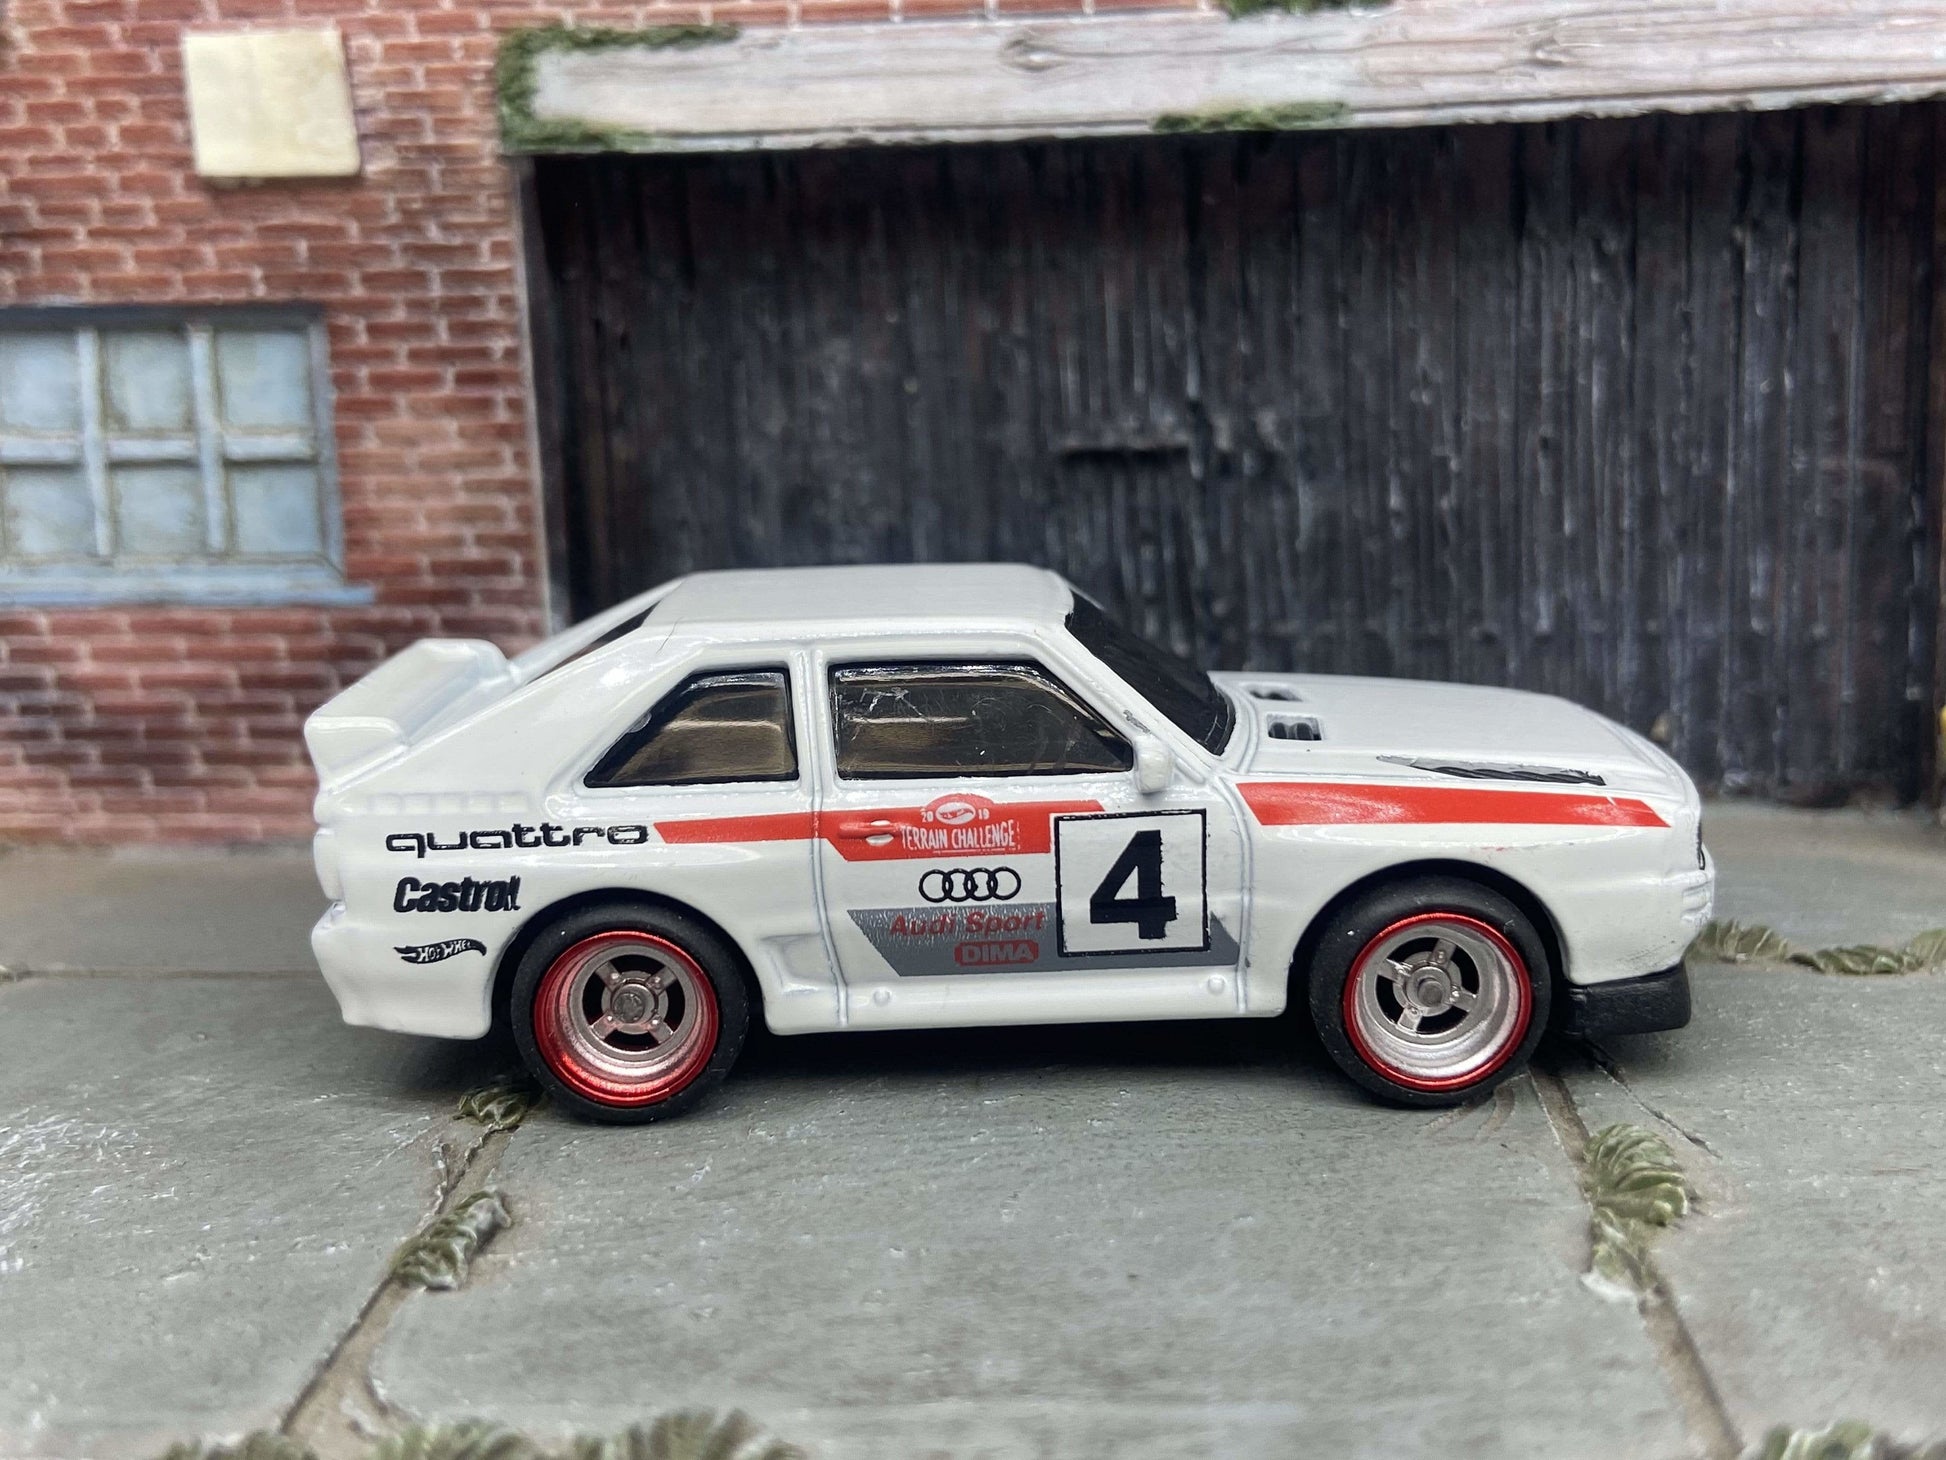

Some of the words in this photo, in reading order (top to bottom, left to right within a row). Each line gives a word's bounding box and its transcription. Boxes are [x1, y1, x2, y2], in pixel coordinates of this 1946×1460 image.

[385, 823, 650, 858] quattro
[901, 824, 948, 850] TERRAIN
[951, 819, 1016, 849] CHALLENGE
[393, 875, 521, 913] Castrol
[1090, 829, 1177, 940] 4
[889, 912, 956, 936] Audi
[965, 911, 1045, 937] Sport
[962, 943, 1034, 963] DIMA
